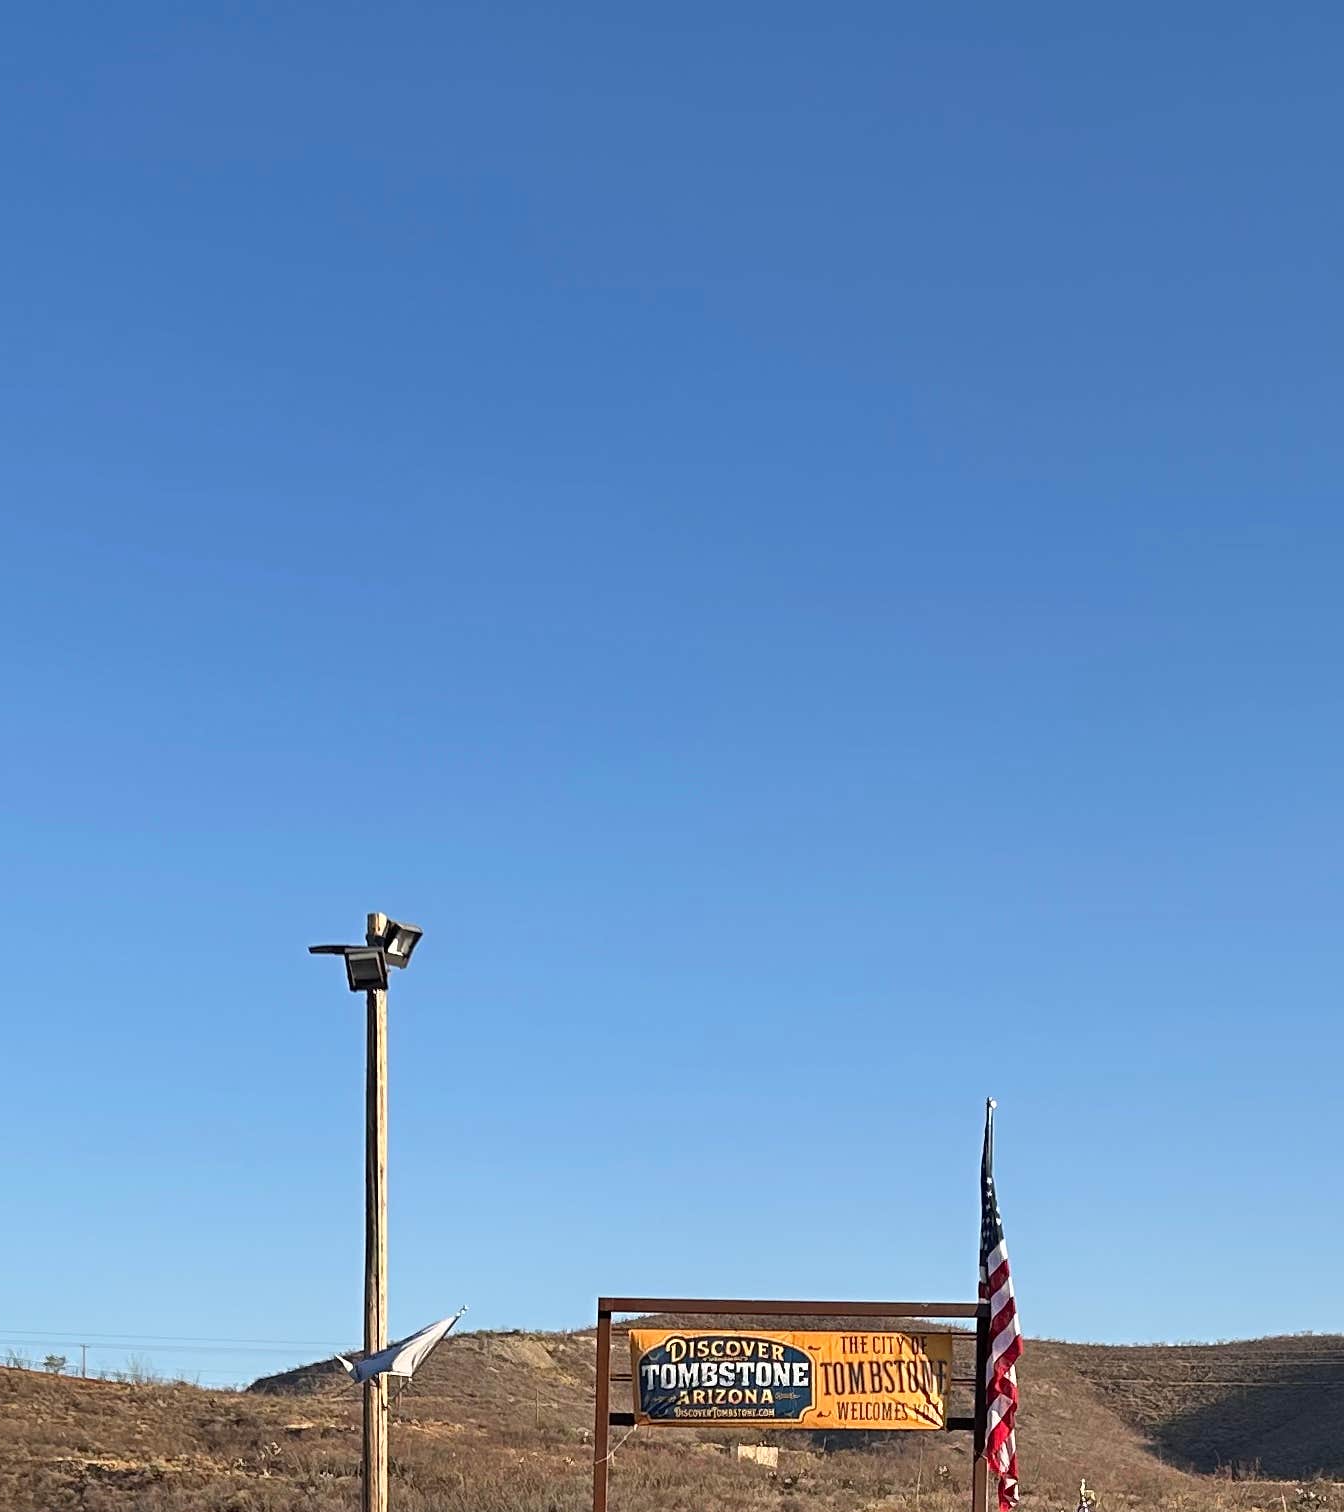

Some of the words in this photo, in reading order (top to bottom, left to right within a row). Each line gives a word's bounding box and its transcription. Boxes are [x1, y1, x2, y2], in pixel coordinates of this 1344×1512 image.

[666, 1338, 784, 1362] DISCOVER
[840, 1336, 869, 1355] THE
[872, 1336, 905, 1355] CITY
[912, 1336, 927, 1355] OF
[641, 1362, 809, 1390] TOMBSTONE
[820, 1360, 948, 1395] TOMBSTONE
[677, 1389, 774, 1405] ARIZONA
[837, 1401, 907, 1421] WELCOMES
